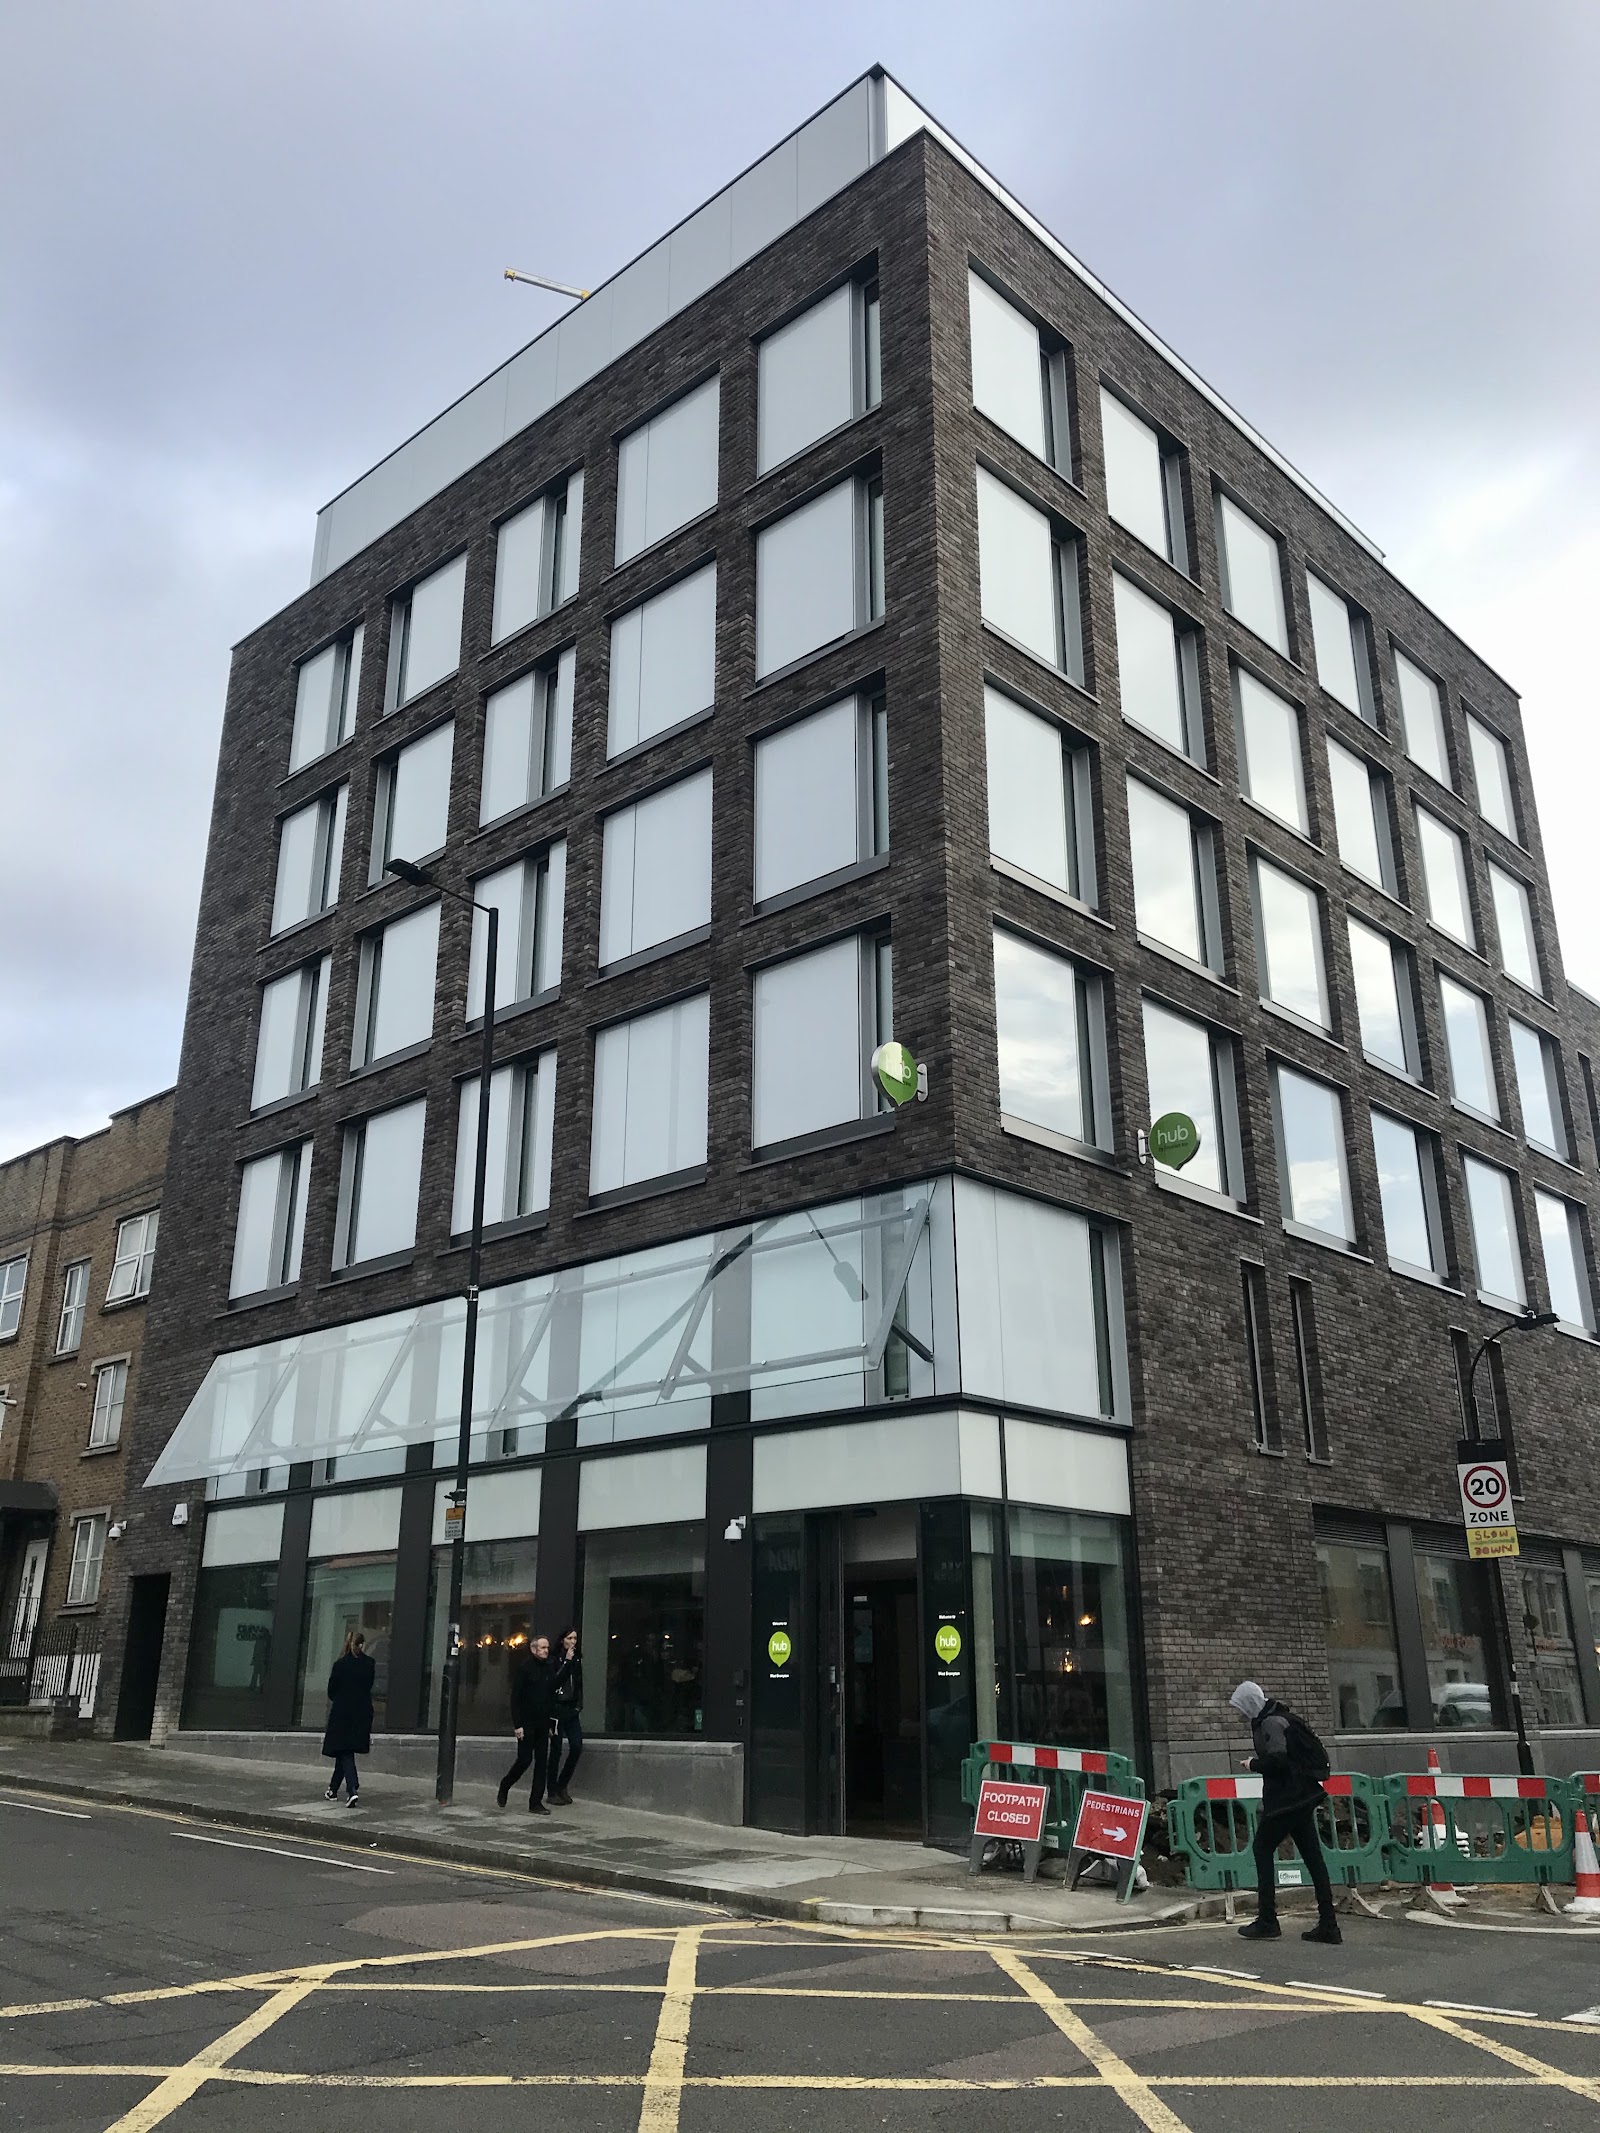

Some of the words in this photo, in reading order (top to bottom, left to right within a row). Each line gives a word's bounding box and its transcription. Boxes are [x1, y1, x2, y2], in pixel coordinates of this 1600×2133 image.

[1157, 1125, 1189, 1146] hub
[1470, 1477, 1500, 1496] 20
[1469, 1510, 1509, 1523] ZONE
[1474, 1529, 1509, 1541] SLOW
[1473, 1544, 1513, 1556] DOWN
[772, 1640, 788, 1652] hub
[939, 1634, 957, 1647] hub
[983, 1791, 1041, 1808] FOOTPATH
[1085, 1799, 1141, 1818] PEDESTRIANS
[987, 1810, 1031, 1825] CLOSED
